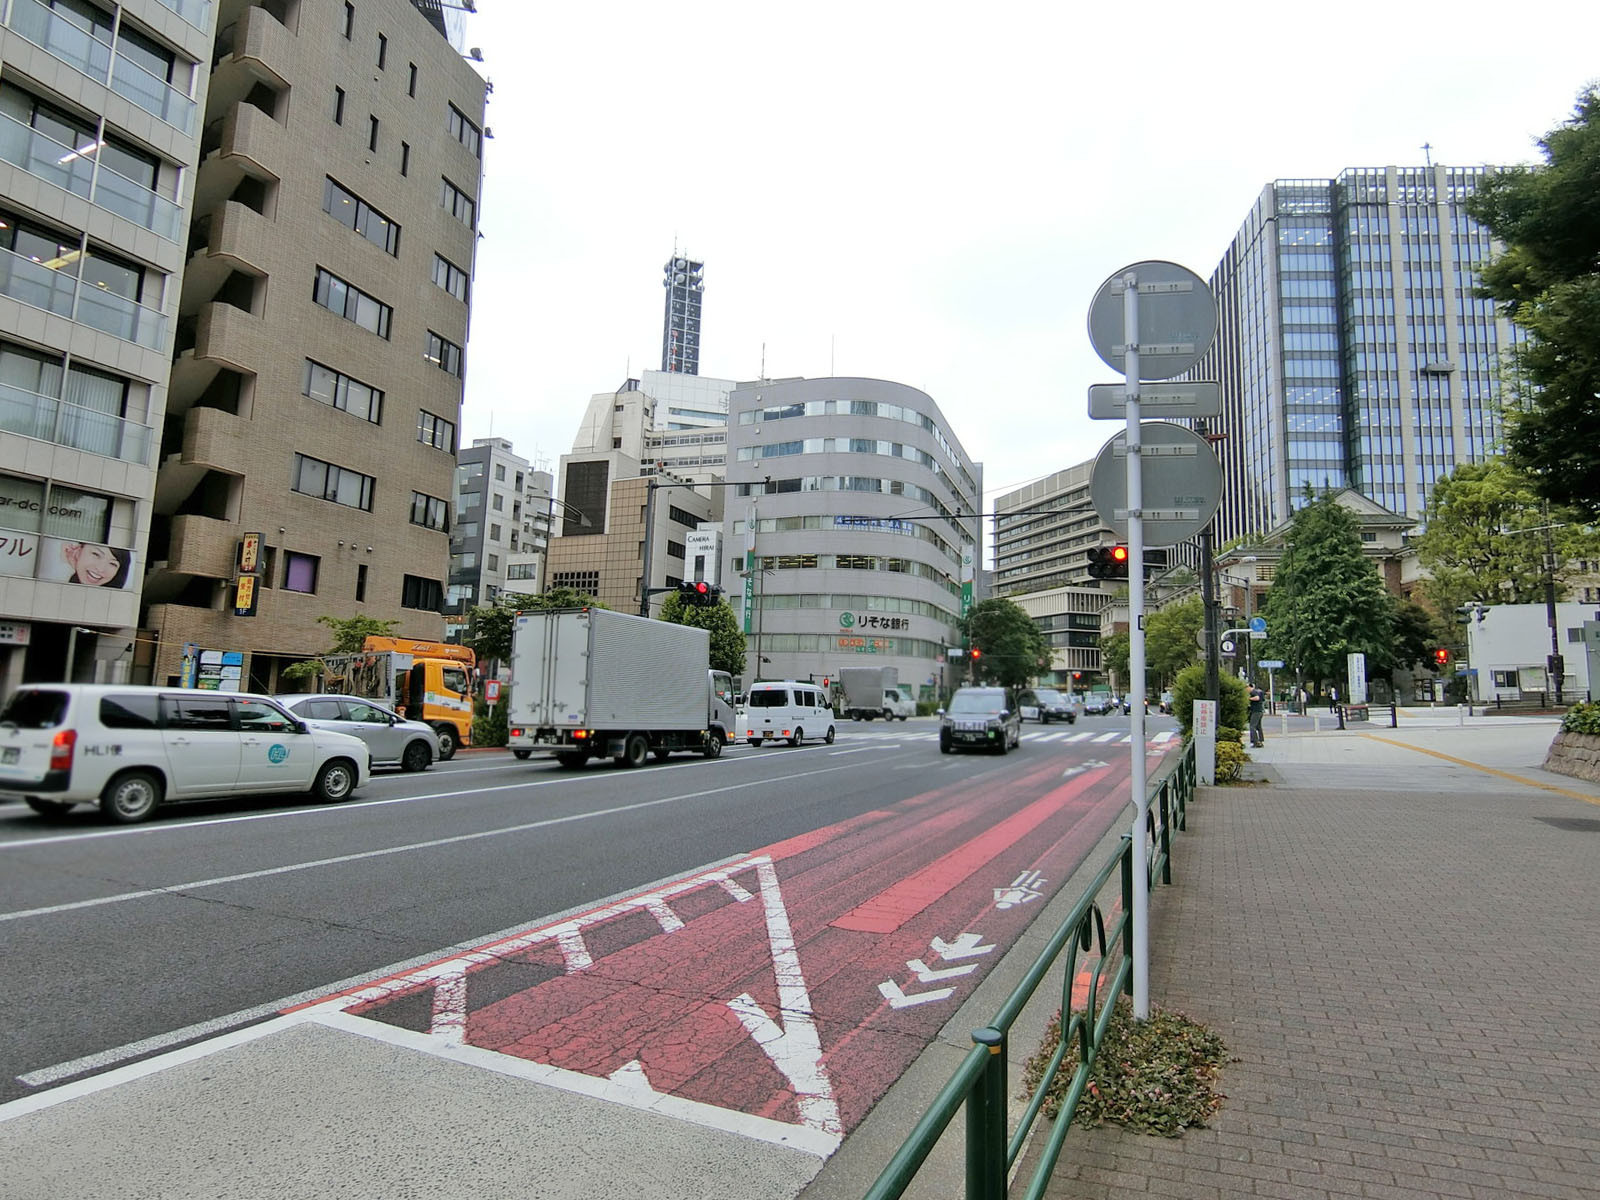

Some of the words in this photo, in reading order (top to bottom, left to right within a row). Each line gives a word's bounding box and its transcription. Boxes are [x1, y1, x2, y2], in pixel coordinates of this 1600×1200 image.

[687, 535, 710, 543] CAMERA
[745, 566, 754, 619] そな銀行
[858, 615, 910, 631] りそな銀行
